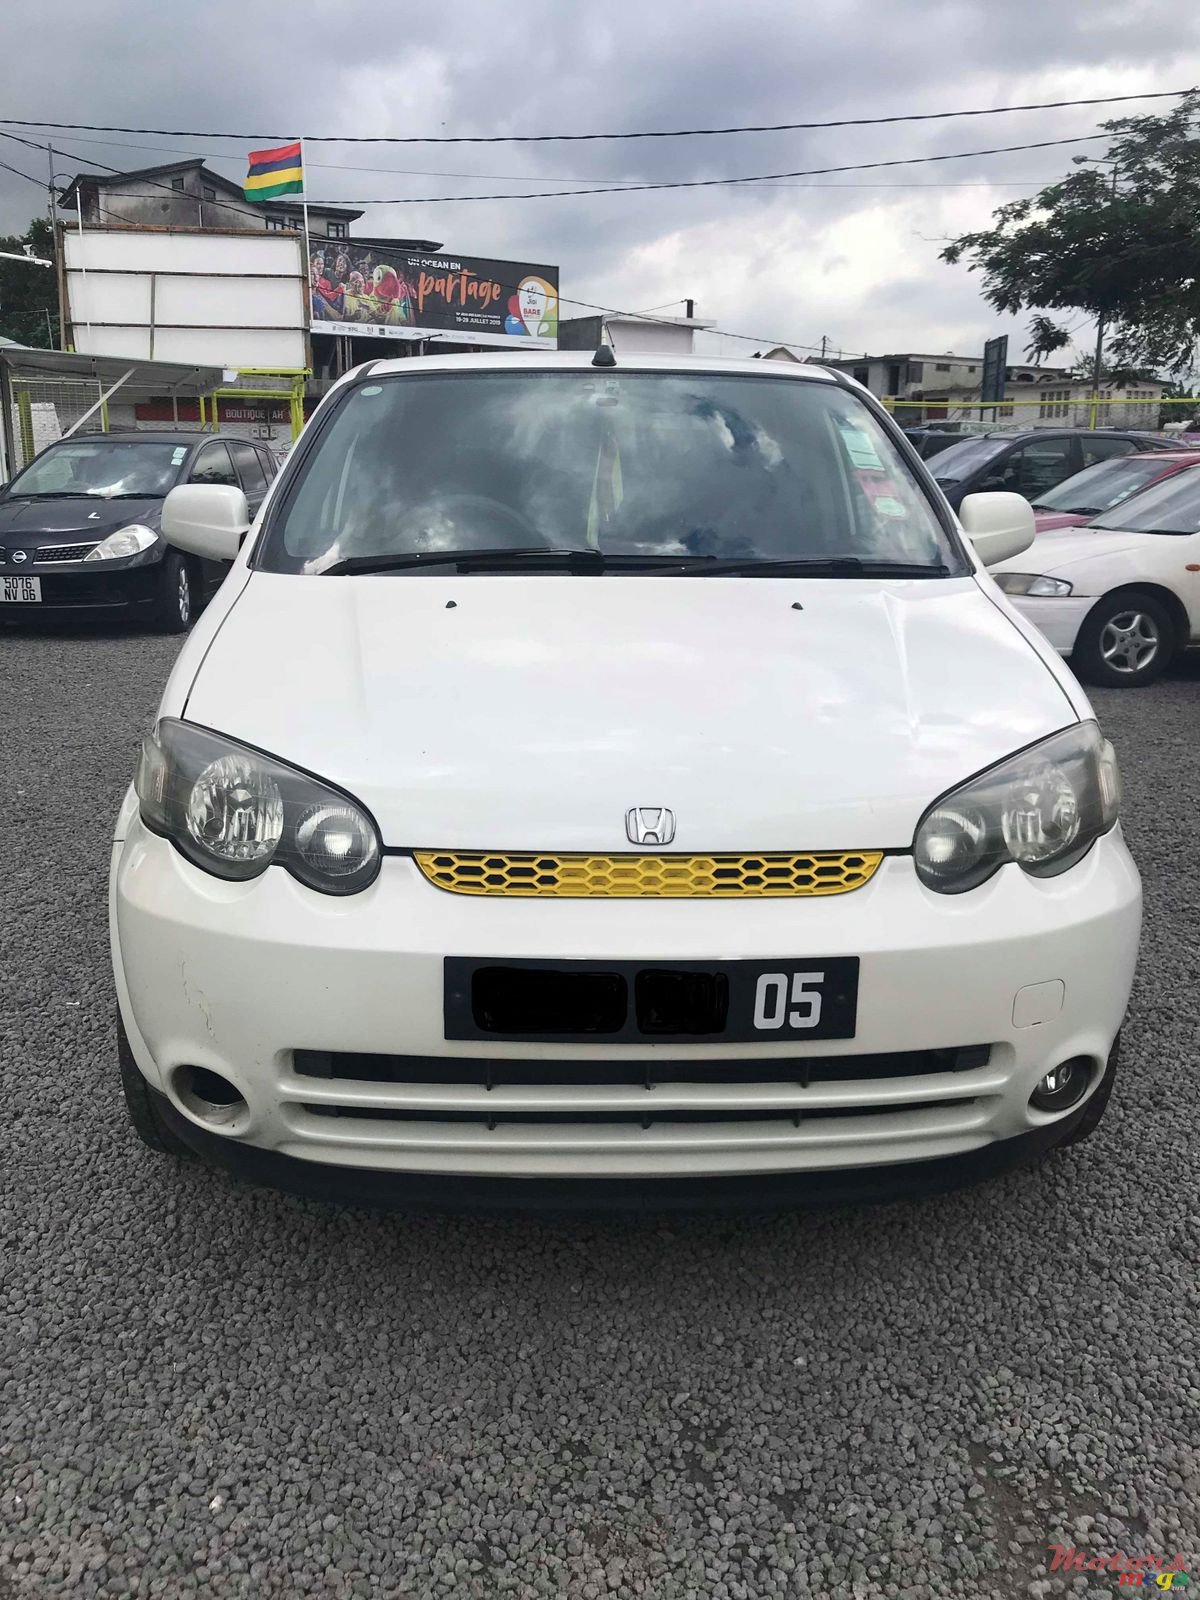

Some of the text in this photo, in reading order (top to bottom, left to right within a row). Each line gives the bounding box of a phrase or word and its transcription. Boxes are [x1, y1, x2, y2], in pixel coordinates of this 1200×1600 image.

[421, 259, 449, 269] OCEAN
[450, 262, 461, 270] EN
[418, 268, 501, 312] partage
[225, 409, 265, 420] BOUTIQUE
[272, 410, 284, 419] AH
[3, 577, 33, 589] 5076
[4, 589, 36, 601] NV 06
[753, 971, 825, 1030] 05
